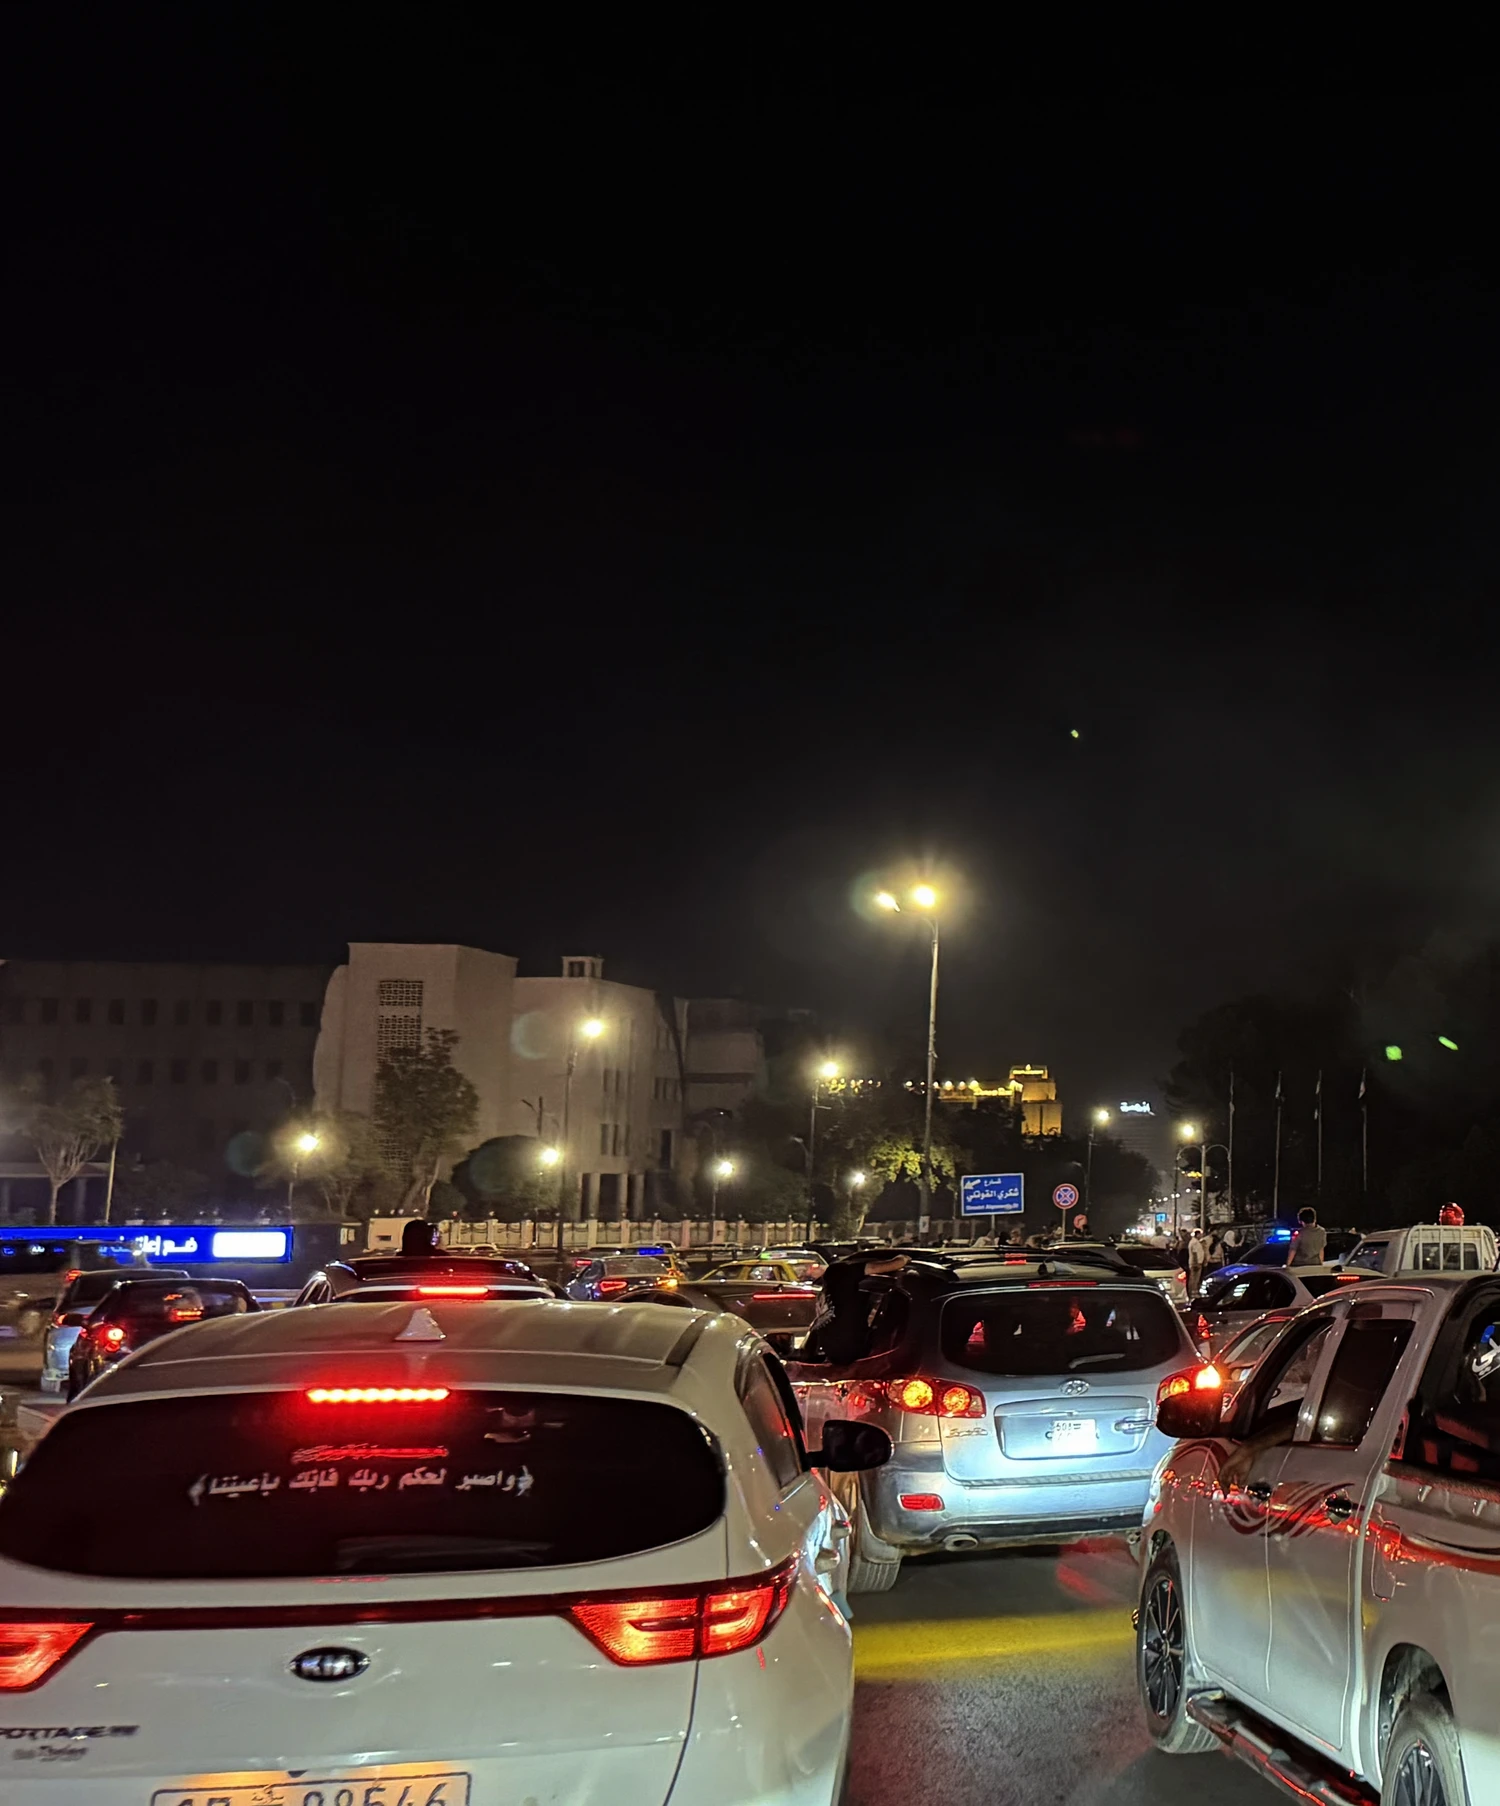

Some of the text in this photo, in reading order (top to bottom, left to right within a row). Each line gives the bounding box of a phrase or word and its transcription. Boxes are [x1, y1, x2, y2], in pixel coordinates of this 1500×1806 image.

[348, 1467, 389, 1492] ربك
[398, 1466, 447, 1489] لحكم
[301, 1655, 355, 1677] KIA
